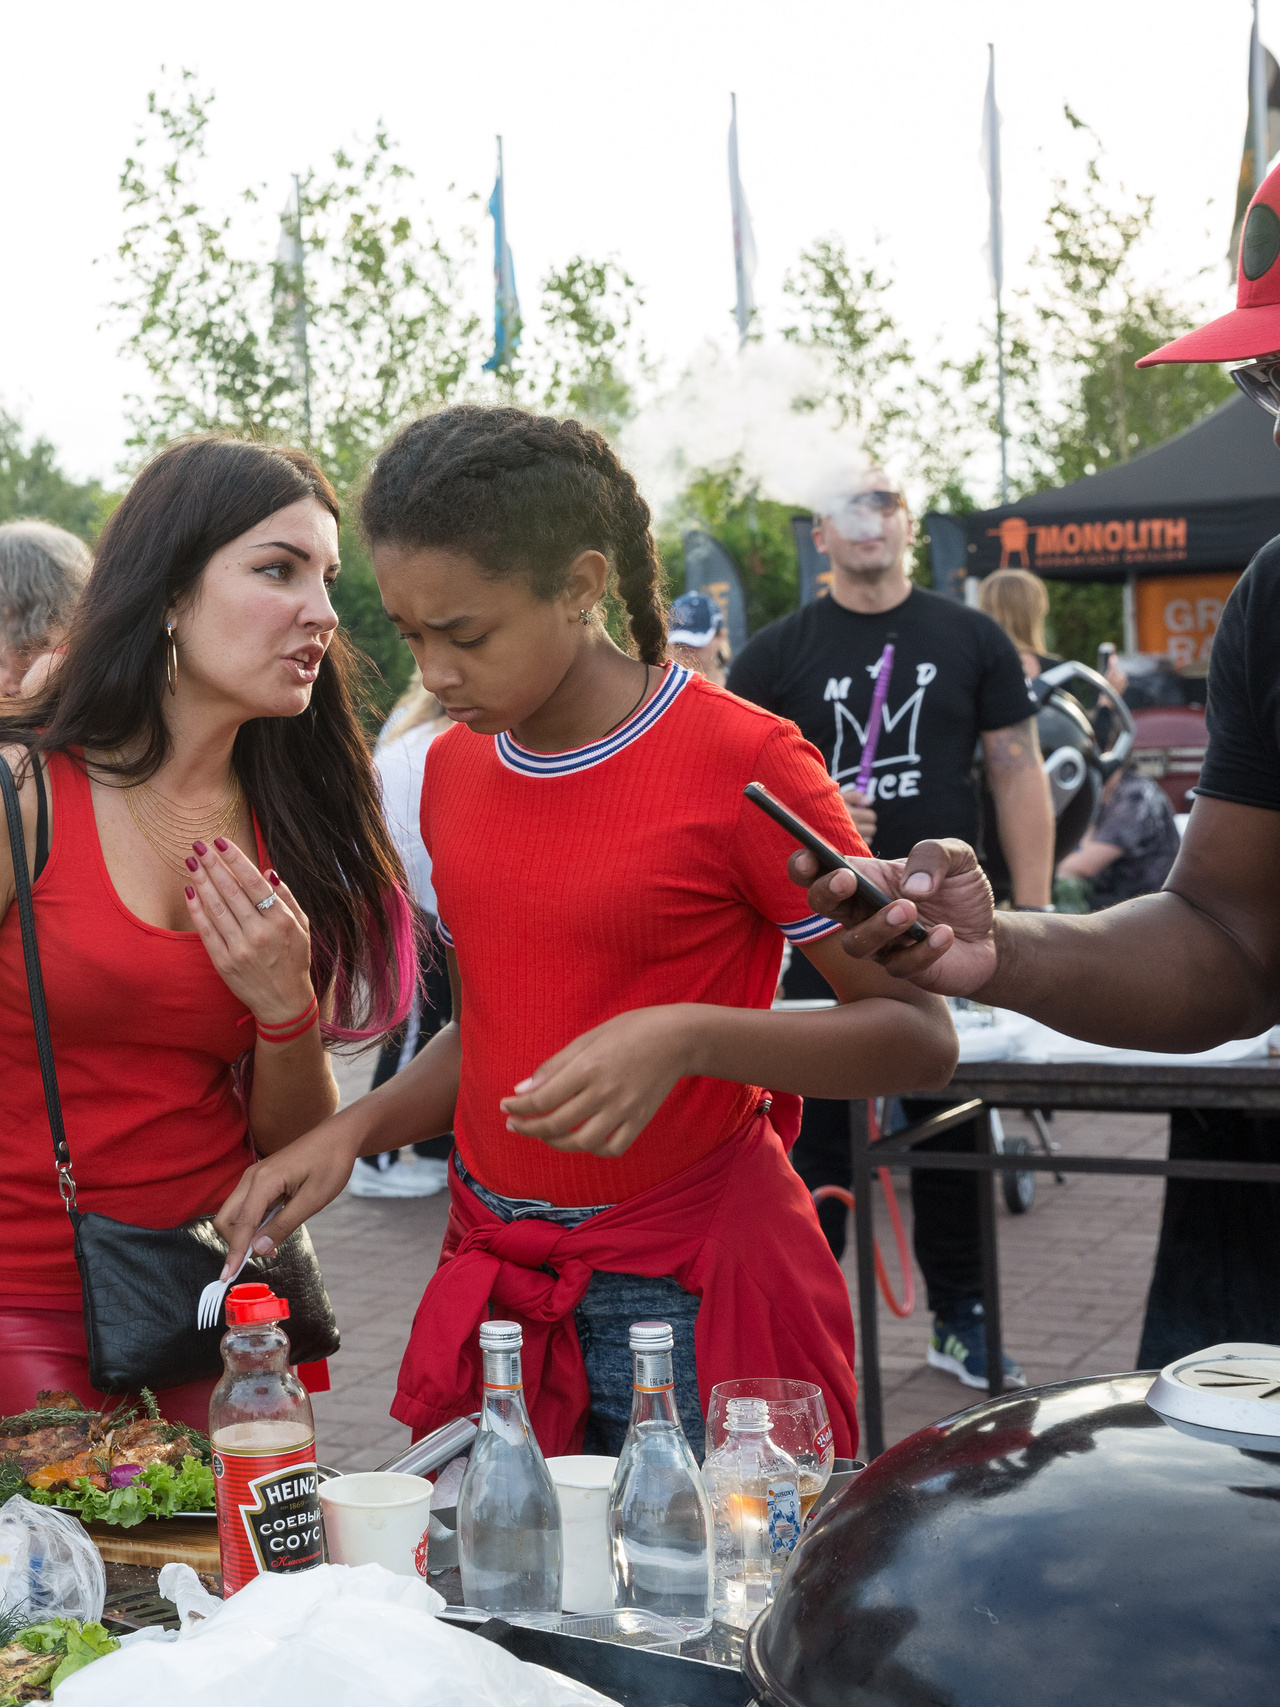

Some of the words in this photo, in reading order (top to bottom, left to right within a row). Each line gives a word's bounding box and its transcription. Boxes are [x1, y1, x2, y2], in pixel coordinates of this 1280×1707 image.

[1034, 516, 1187, 554] MONOLITH
[265, 1476, 316, 1506] HEINZ
[289, 1500, 305, 1510] 1869
[260, 1507, 321, 1536] СОЕВЫЙ
[270, 1526, 320, 1551] СОУС
